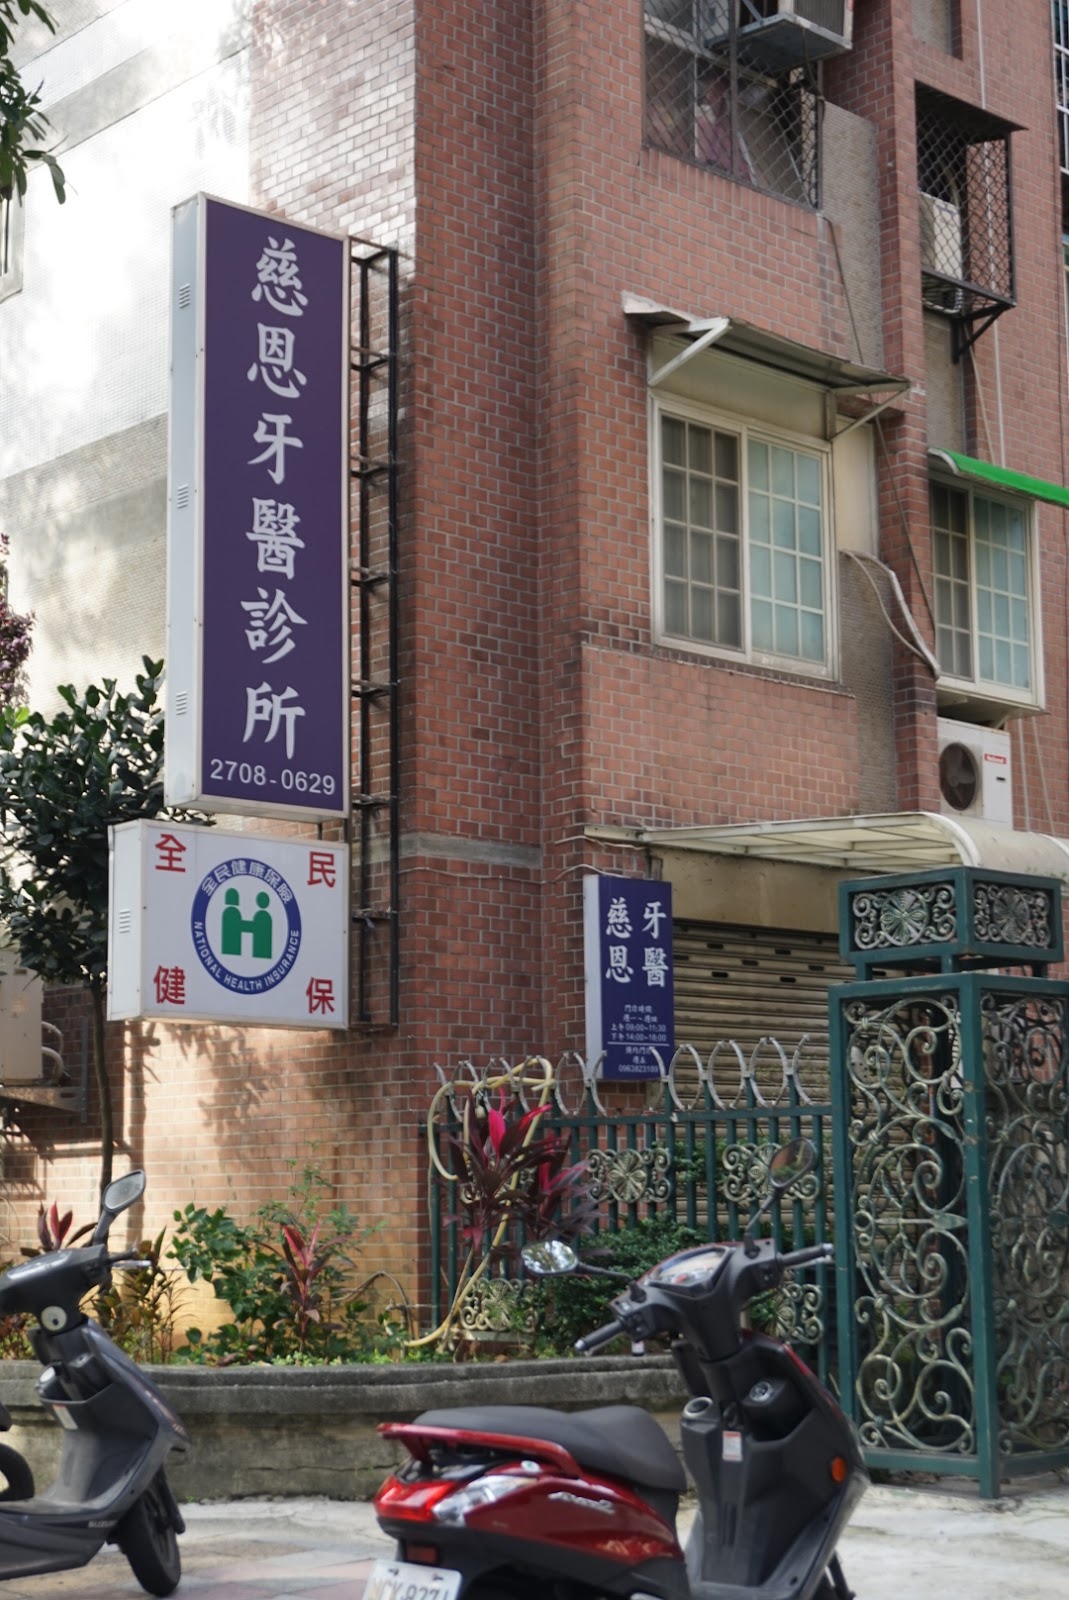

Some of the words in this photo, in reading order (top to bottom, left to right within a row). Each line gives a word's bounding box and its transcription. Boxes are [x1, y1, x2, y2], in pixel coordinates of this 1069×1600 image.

[241, 236, 308, 760] 慈恩牙醫診所
[210, 758, 336, 795] 2708-0629
[193, 920, 222, 978] NATIONAL
[223, 974, 263, 991] HEALTH
[263, 929, 300, 987] INSURANCE
